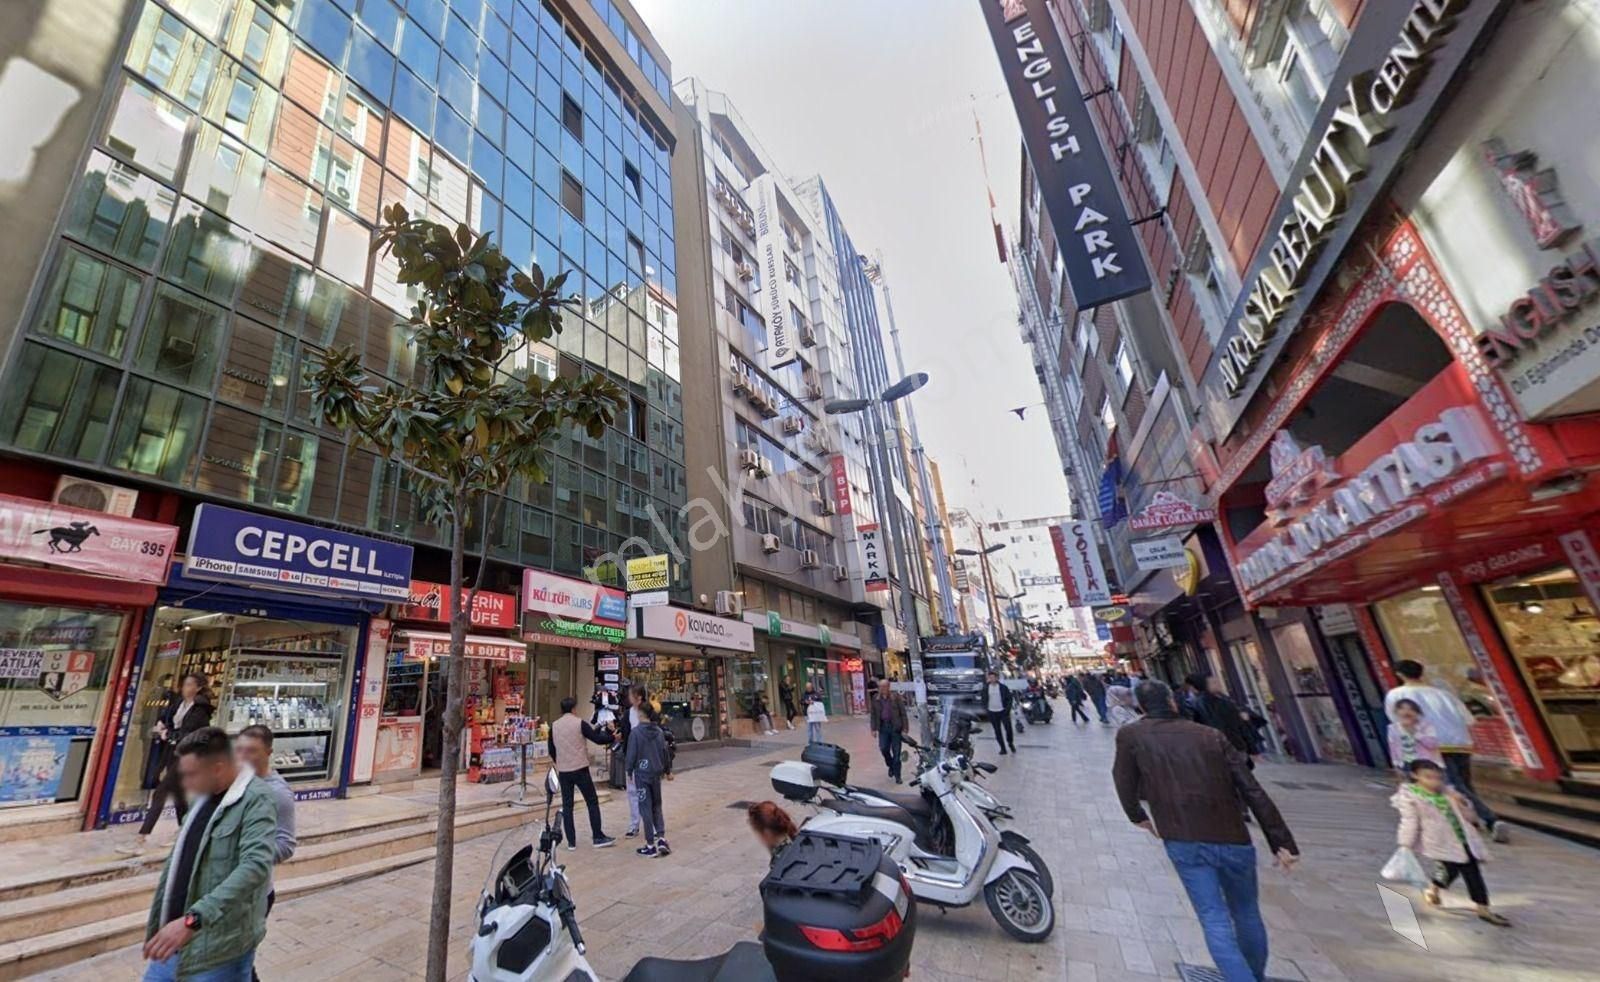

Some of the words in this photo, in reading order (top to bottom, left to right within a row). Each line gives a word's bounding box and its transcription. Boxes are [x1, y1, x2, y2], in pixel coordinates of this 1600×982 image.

[1012, 22, 1081, 161] ENGLISH
[1068, 183, 1123, 280] PARK
[1271, 80, 1373, 288] BEAUTY
[836, 477, 849, 510] BTP
[140, 541, 166, 558] 395
[234, 526, 383, 577] CEPCELL
[862, 533, 880, 580] MARKA
[195, 558, 233, 573] iPhone
[238, 566, 278, 578] SAMSUNG
[687, 615, 725, 637] kavalaa
[0, 650, 44, 658] EVREN
[434, 642, 474, 655] DEN
[0, 659, 42, 669] ATILIK
[119, 813, 140, 823] CEP
